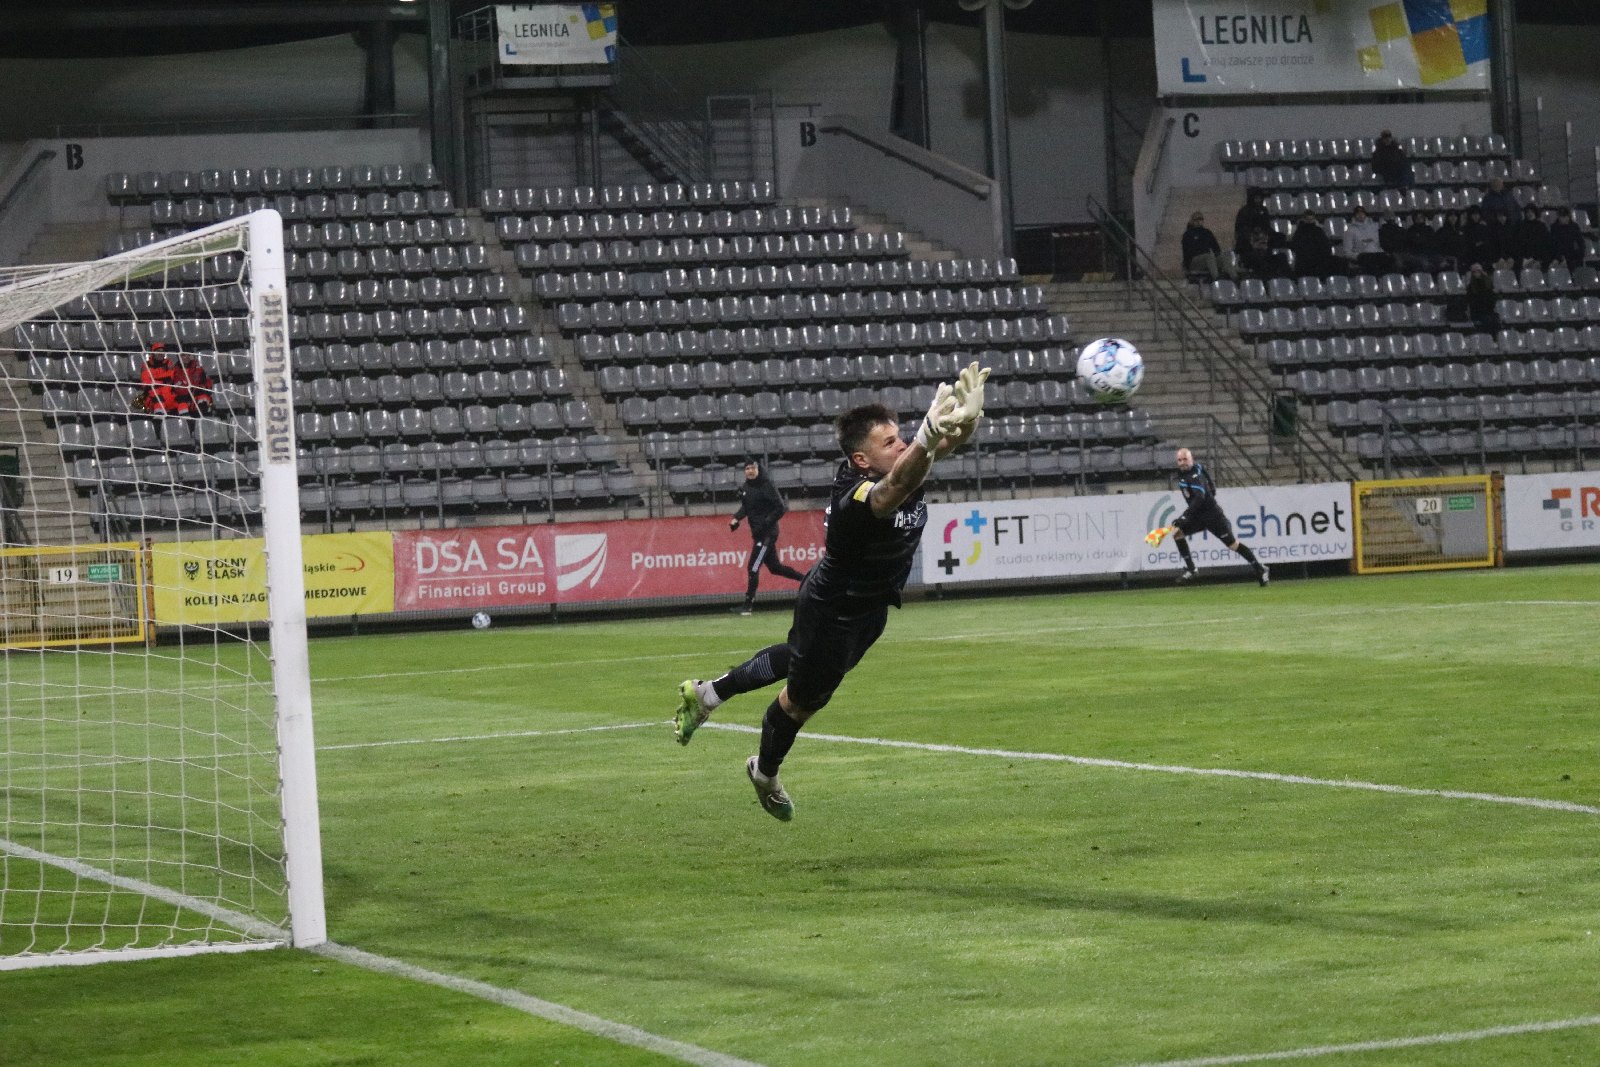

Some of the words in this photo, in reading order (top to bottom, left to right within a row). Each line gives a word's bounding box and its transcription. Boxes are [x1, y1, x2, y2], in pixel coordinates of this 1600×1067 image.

[514, 23, 570, 38] LEGNICA
[1200, 14, 1313, 44] LEGNICA
[800, 121, 817, 147] B
[1183, 113, 1200, 138] C
[66, 144, 84, 170] B
[1422, 500, 1438, 511] 20
[1188, 501, 1346, 541] shnet
[415, 538, 488, 575] DSA
[496, 536, 544, 571] SA
[631, 548, 748, 570] Pomnażamy
[995, 553, 1034, 565] studio
[1036, 550, 1083, 563] reklamy
[55, 569, 73, 583] 19
[418, 582, 492, 599] Financial
[498, 580, 547, 596] Group
[185, 595, 219, 607] KOLEJ
